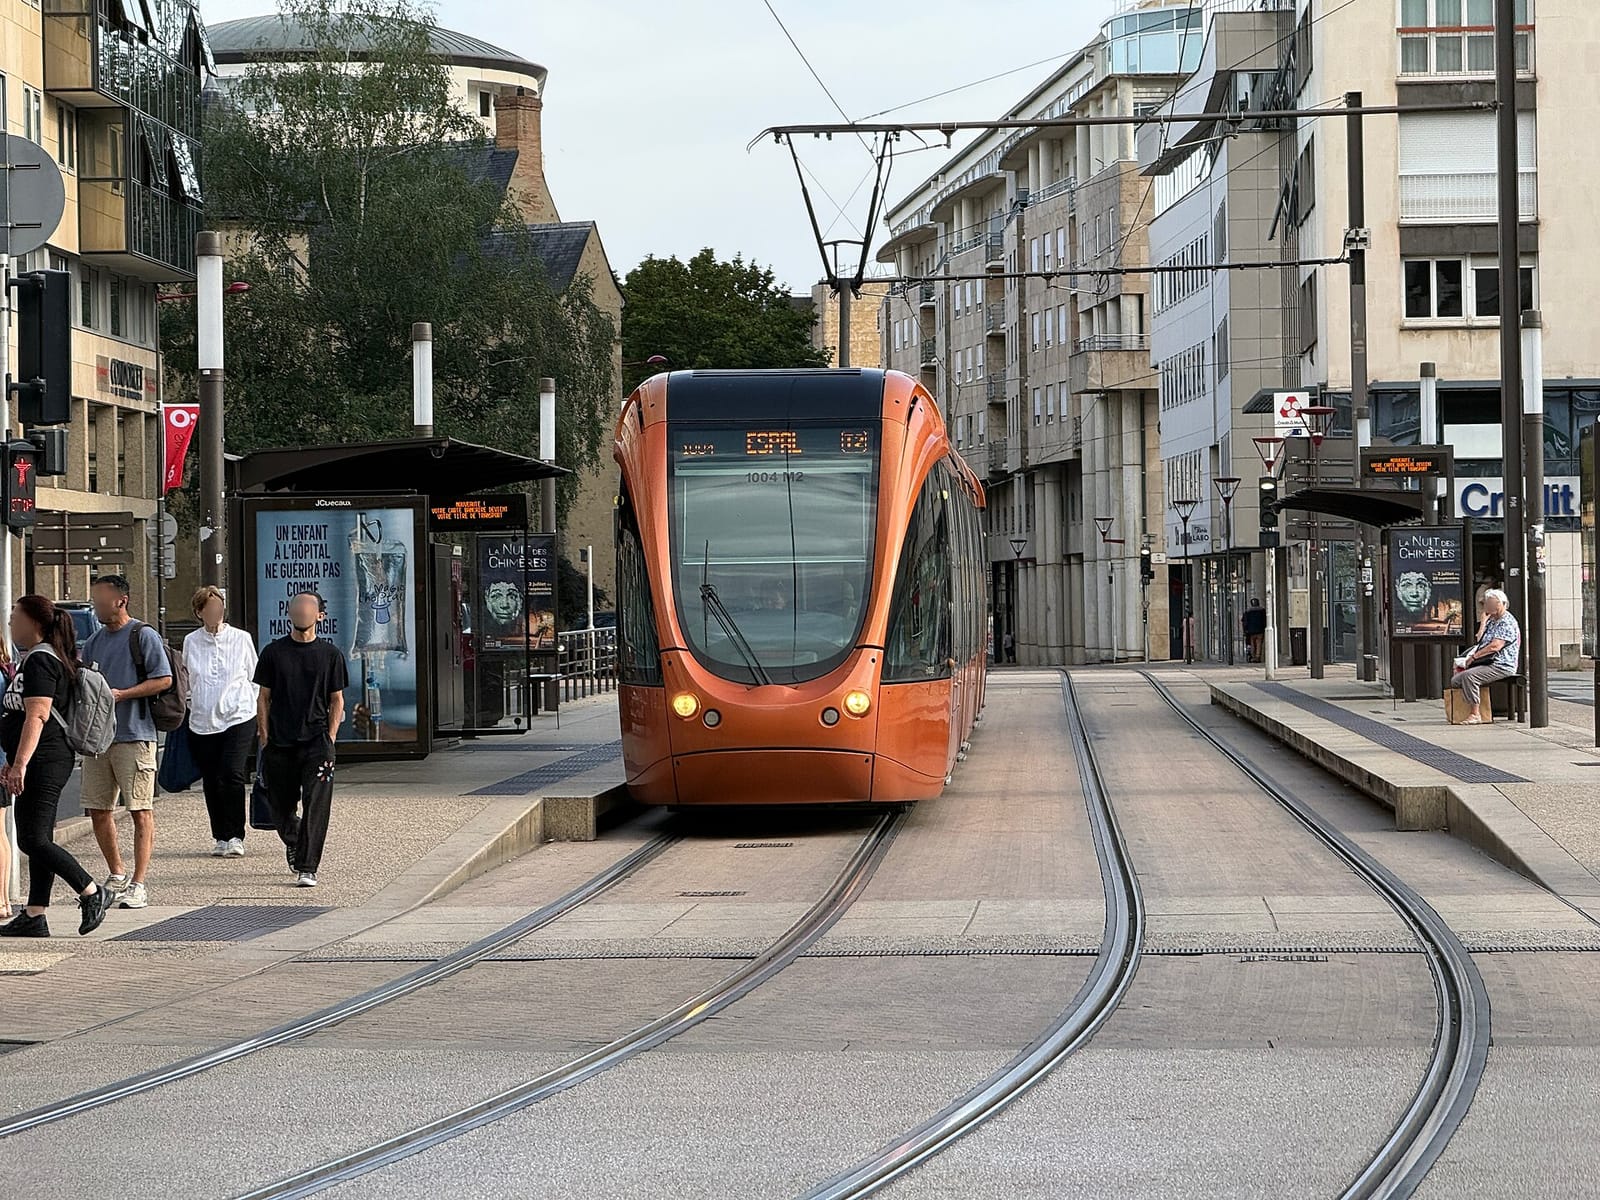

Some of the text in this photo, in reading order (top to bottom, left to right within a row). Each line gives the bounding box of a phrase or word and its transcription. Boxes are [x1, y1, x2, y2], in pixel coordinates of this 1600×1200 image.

[746, 432, 802, 454] ESPAL
[745, 471, 804, 483] 1004 M2
[1460, 482, 1575, 517] Crit
[276, 525, 328, 541] UN ENFANT
[274, 541, 331, 560] À L'HÔPITAL
[265, 560, 341, 579] NE GUÉRIRA PAS
[270, 619, 292, 635] MAIS
